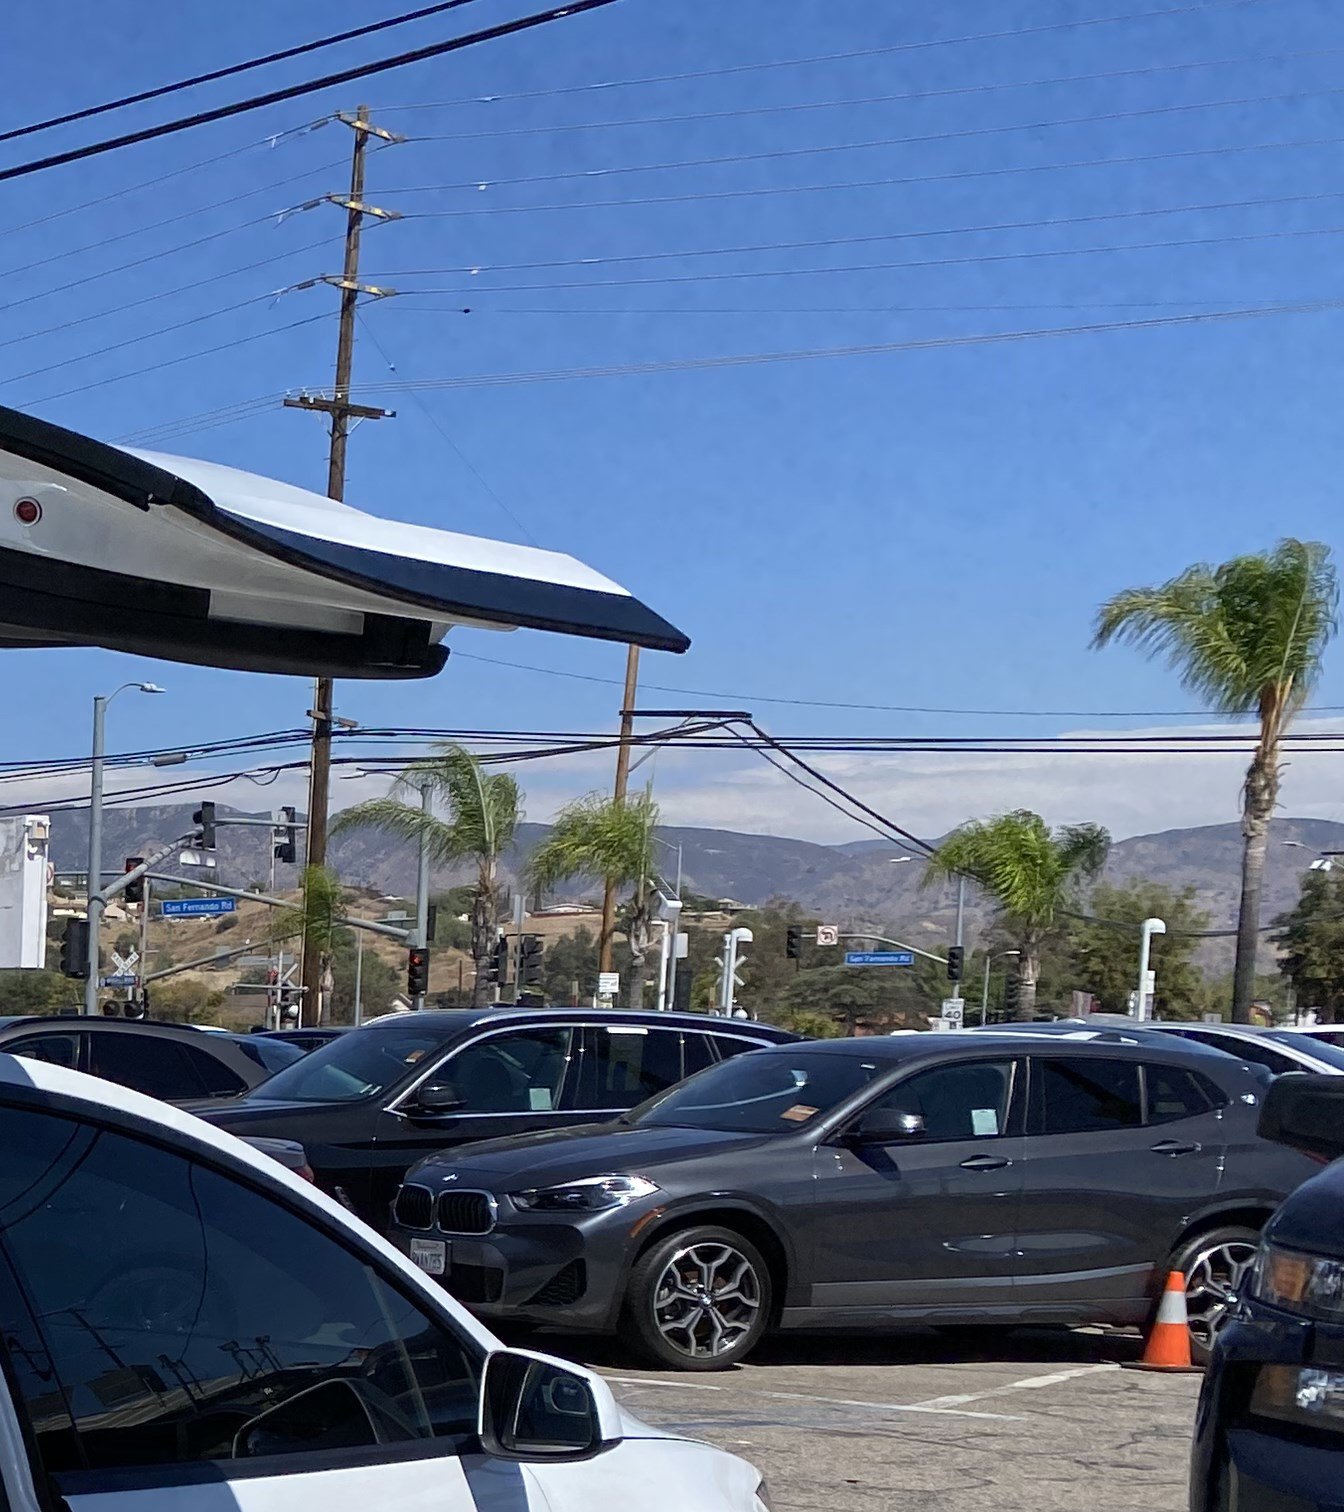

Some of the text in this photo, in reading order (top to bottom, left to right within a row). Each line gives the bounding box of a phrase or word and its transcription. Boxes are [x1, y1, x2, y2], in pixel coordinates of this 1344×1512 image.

[166, 901, 233, 912] San Fernando Rd
[944, 1010, 962, 1019] 40
